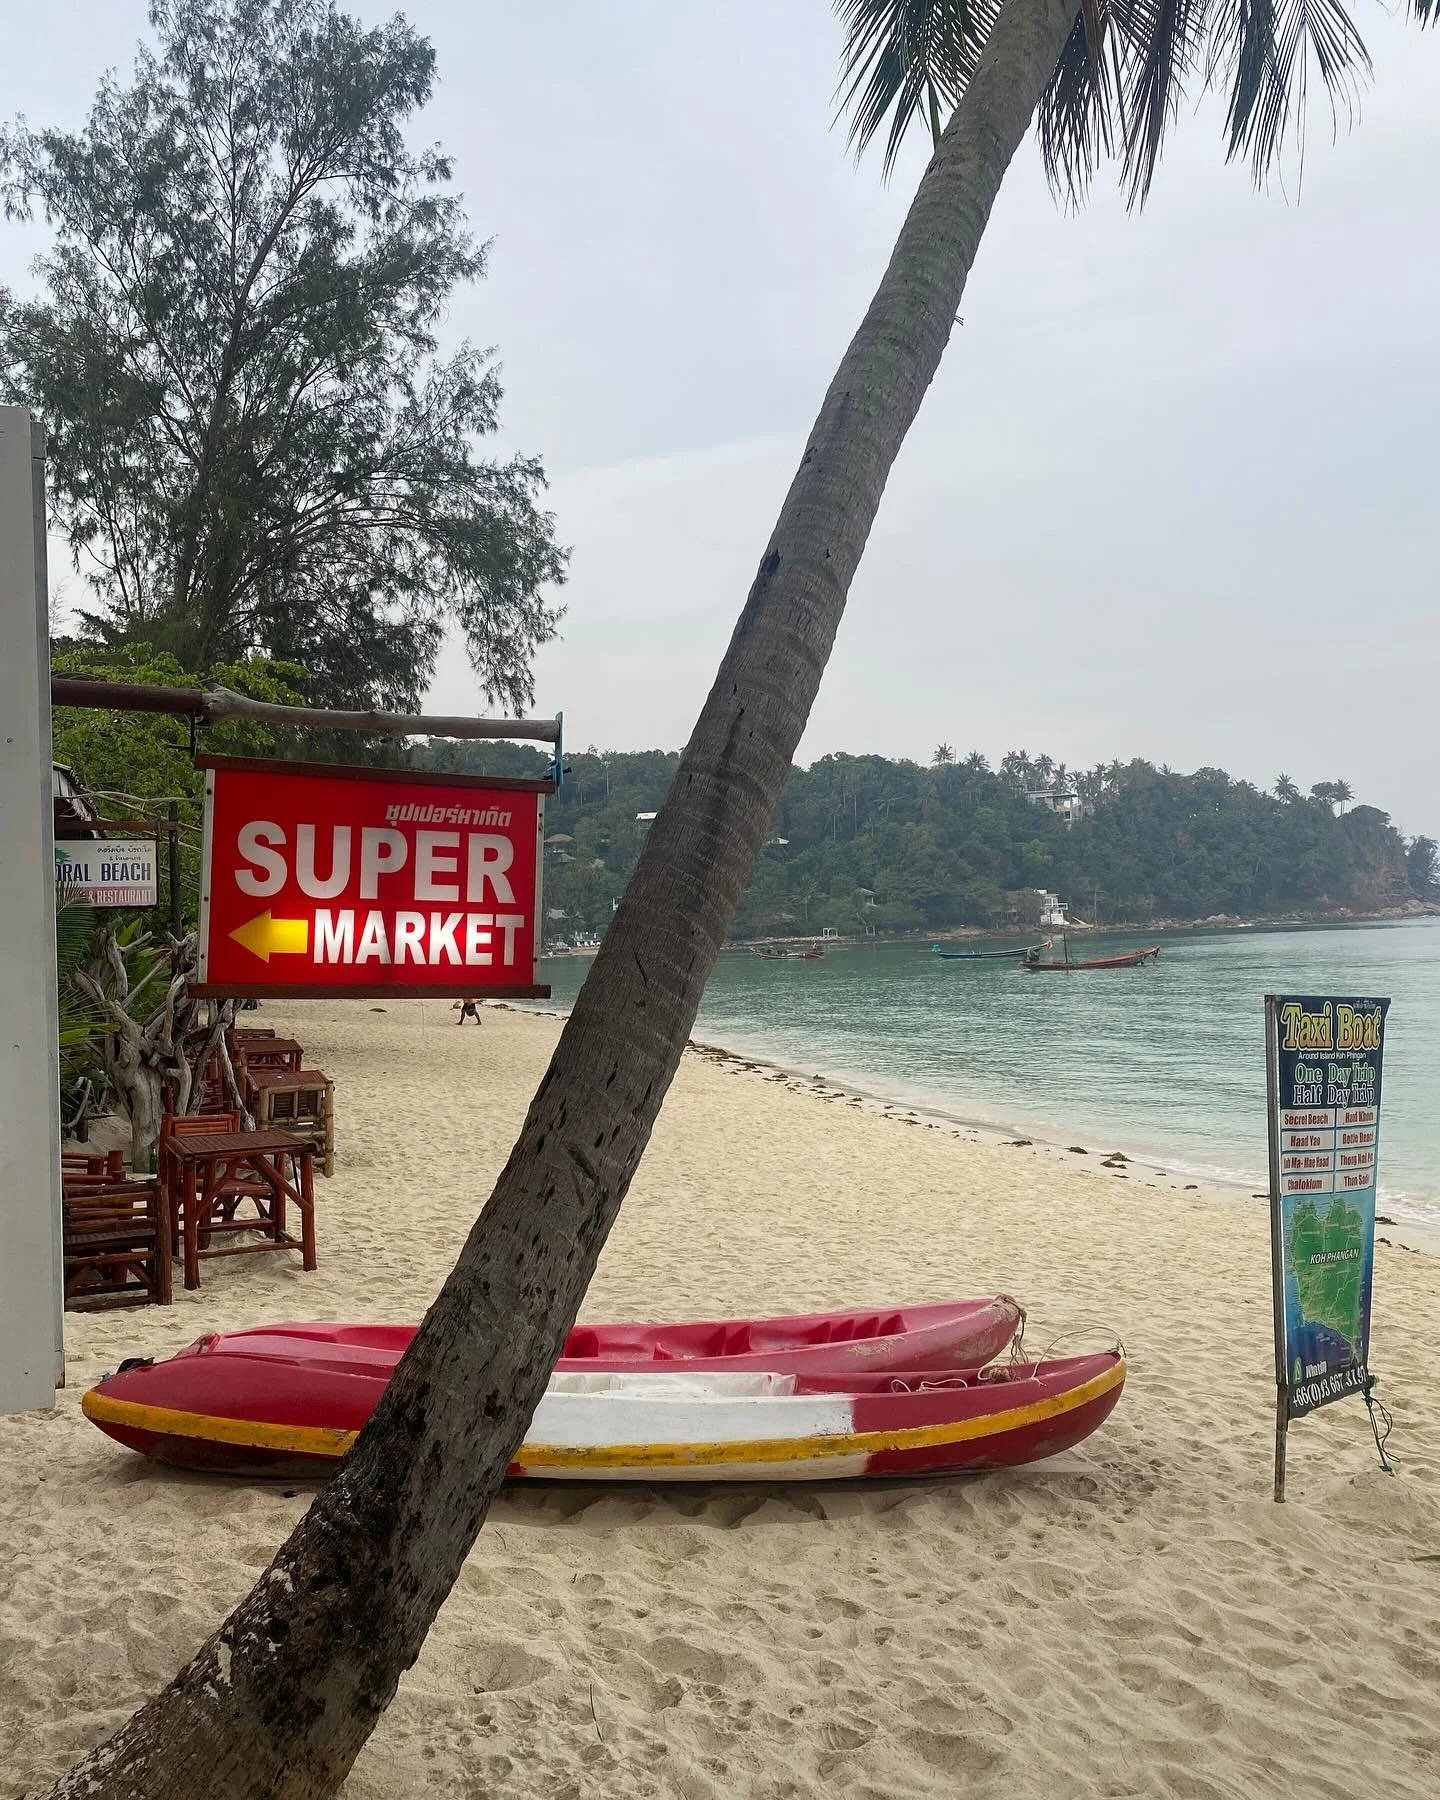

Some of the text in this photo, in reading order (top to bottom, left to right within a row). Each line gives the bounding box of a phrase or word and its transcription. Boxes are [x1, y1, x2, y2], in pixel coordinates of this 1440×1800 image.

[234, 820, 517, 904] SUPER
[101, 863, 151, 881] BEACH
[97, 889, 152, 904] RESTAURANT
[313, 908, 525, 966] MARKET
[1281, 1001, 1382, 1051] Taxi Boat
[1298, 1051, 1319, 1060] Around
[1295, 1062, 1375, 1087] One Day Trip
[1293, 1083, 1375, 1108] Half Day Trip
[1284, 1113, 1329, 1125] Secret Beach
[1290, 1135, 1321, 1147] Haad Yao
[1310, 1249, 1360, 1265] KOH PHANGAN
